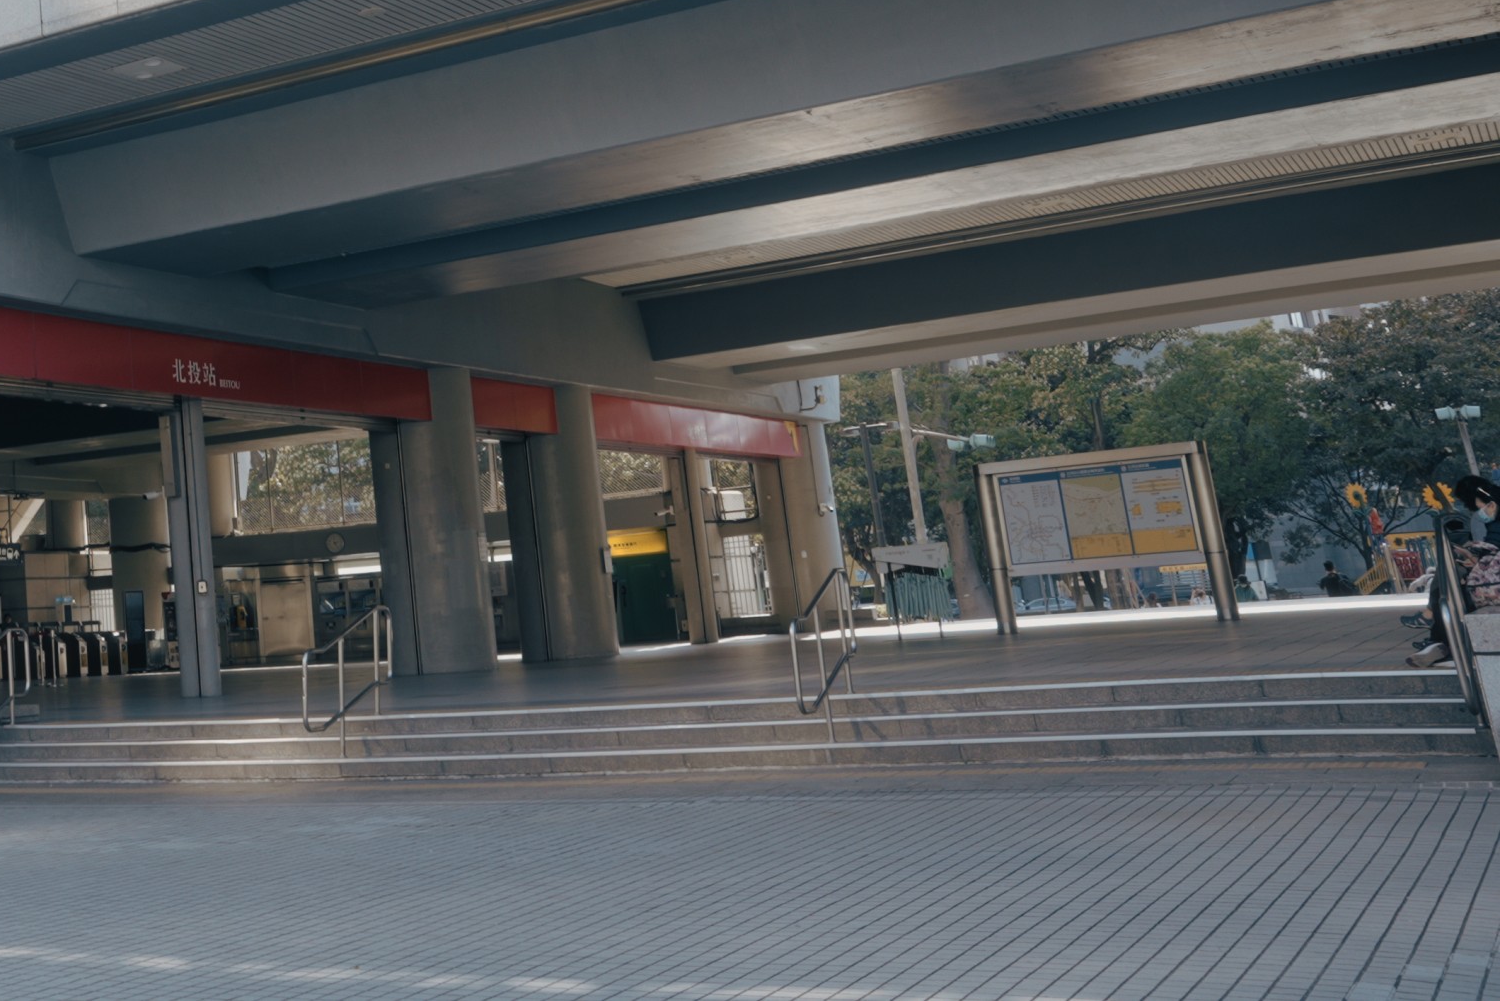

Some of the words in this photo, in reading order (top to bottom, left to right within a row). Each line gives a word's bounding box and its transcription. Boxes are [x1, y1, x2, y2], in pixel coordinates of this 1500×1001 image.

[172, 358, 216, 386] 北投站
[220, 379, 240, 389] BEITOU
